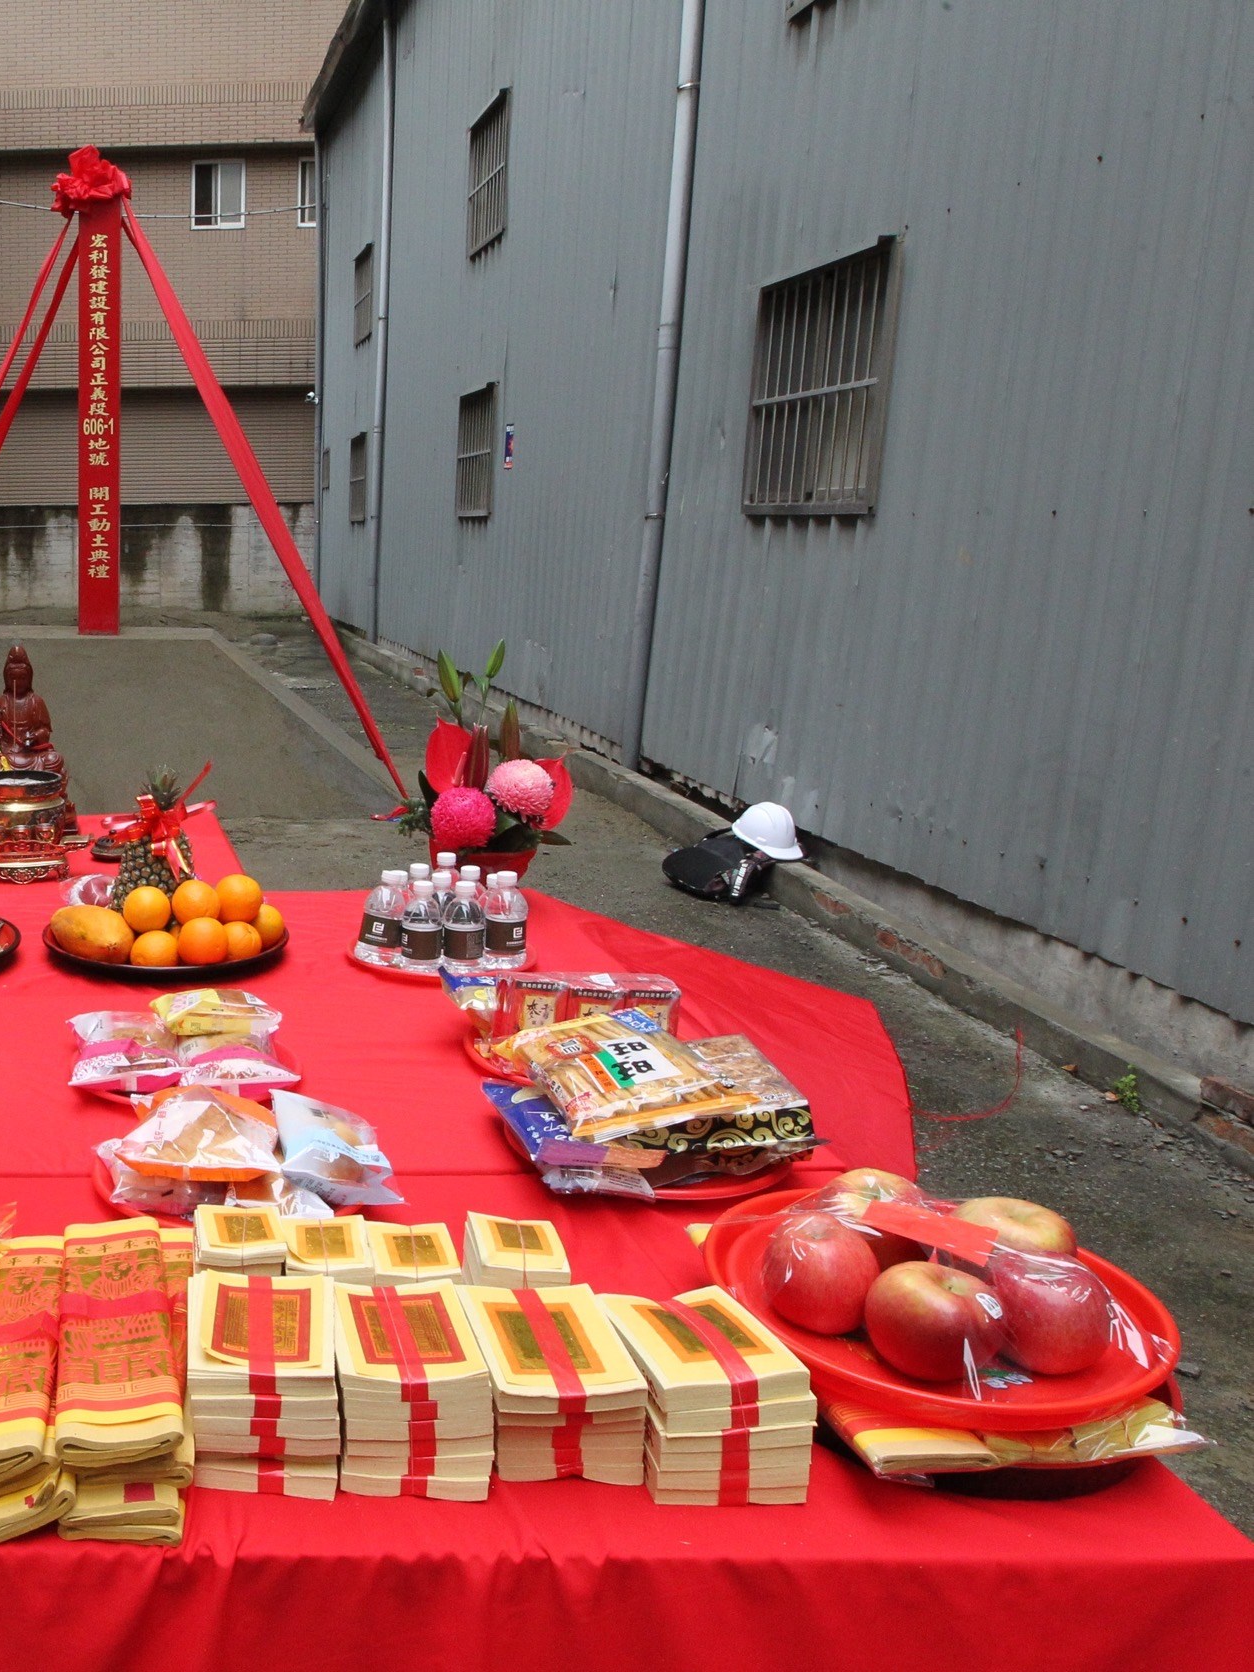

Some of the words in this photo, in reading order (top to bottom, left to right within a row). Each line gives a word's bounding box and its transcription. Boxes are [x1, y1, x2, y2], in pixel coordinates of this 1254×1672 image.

[83, 234, 114, 466] 宏利發建設有限公司正義段606-1地號
[87, 486, 111, 578] 開工動土典禮
